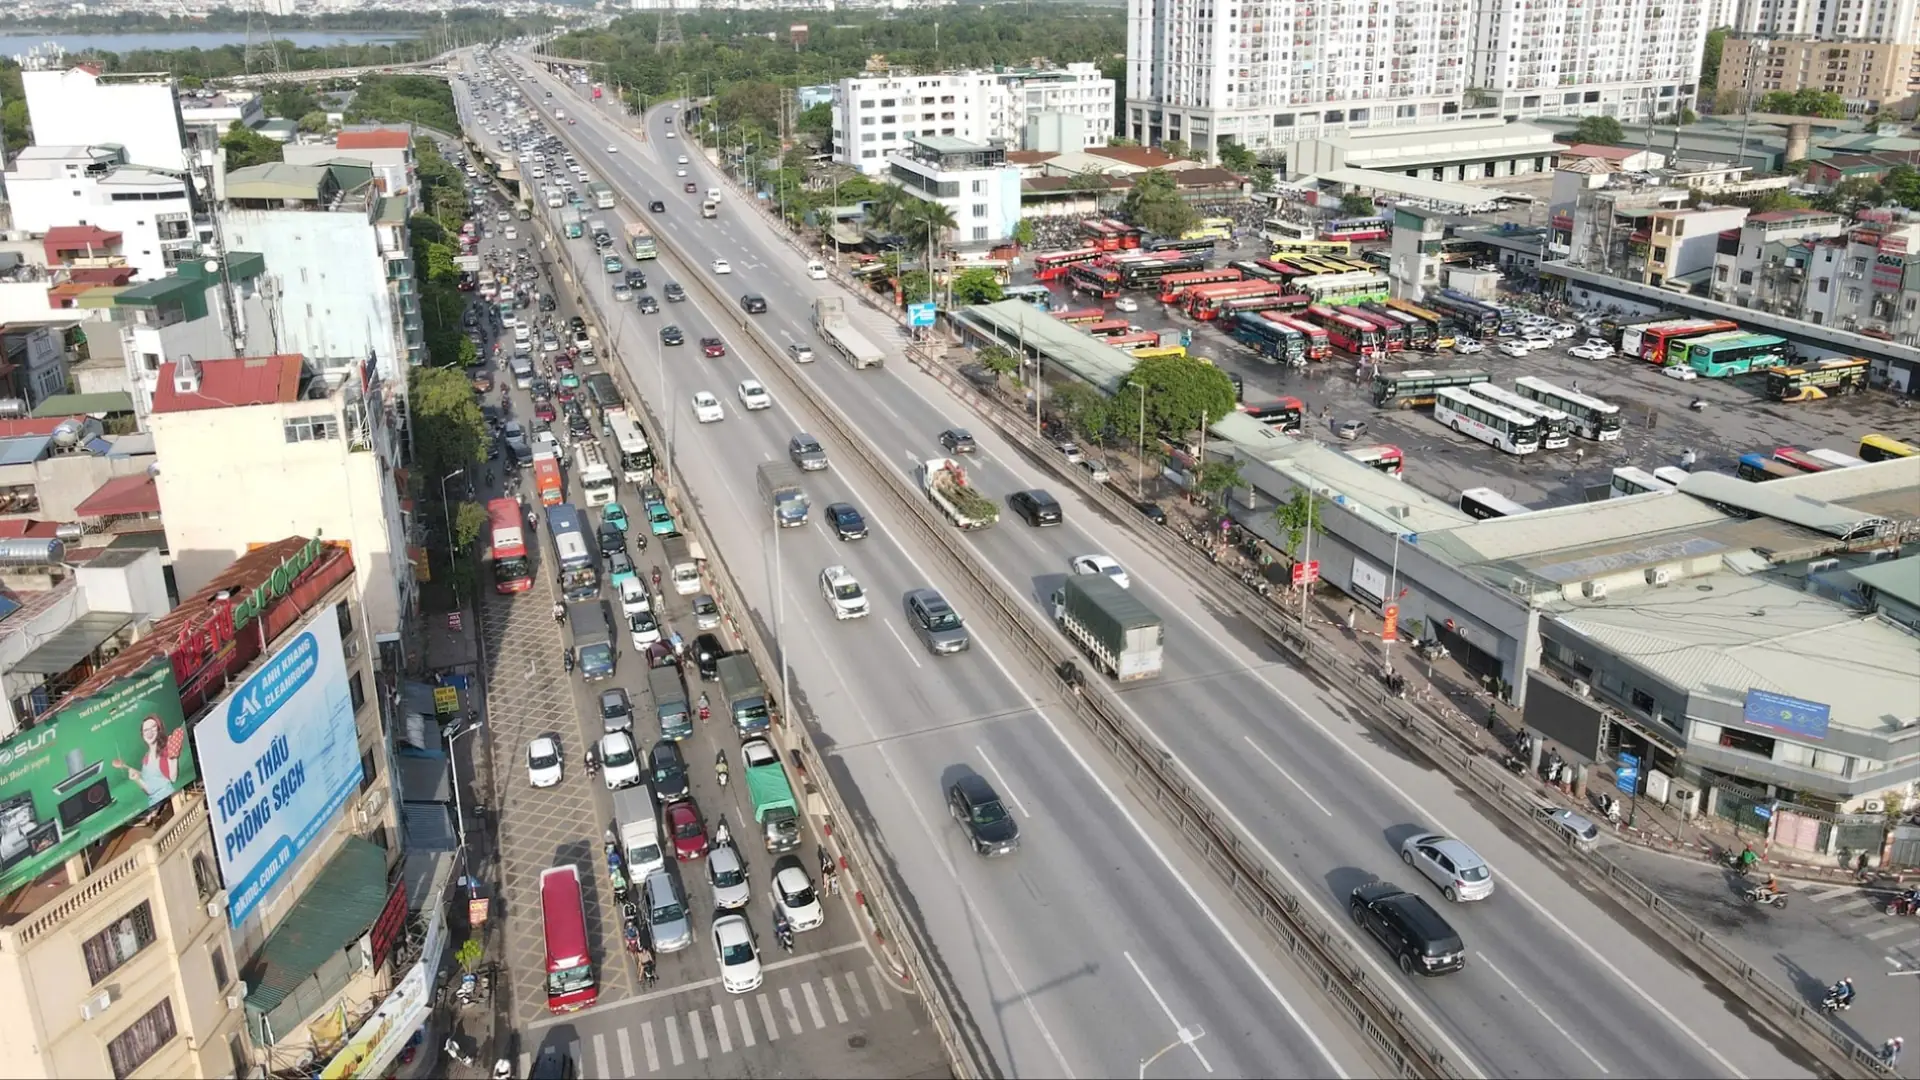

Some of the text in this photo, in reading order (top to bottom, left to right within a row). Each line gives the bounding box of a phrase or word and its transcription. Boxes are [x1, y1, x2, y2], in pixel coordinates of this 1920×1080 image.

[235, 536, 320, 630] eurosun
[261, 667, 281, 690] ANH
[281, 638, 311, 671] KHANG
[264, 655, 314, 708] CLEANROOM
[217, 734, 290, 824] TỔNG THẦU
[224, 759, 306, 863] PHÒNG SẠCH
[234, 845, 291, 919] akme.com.vn
